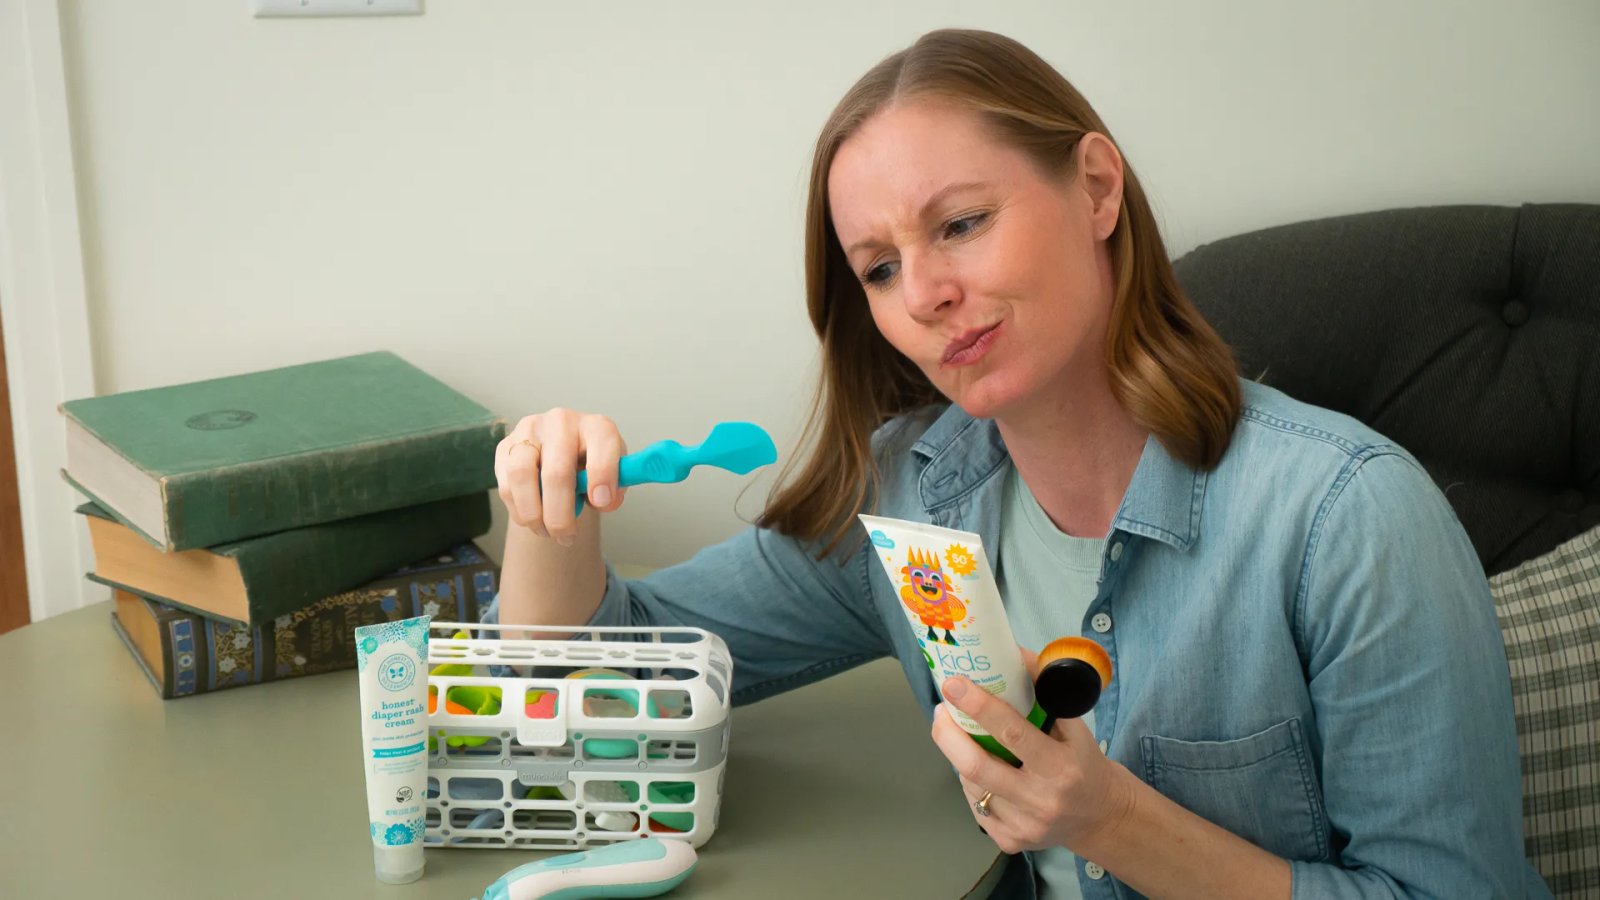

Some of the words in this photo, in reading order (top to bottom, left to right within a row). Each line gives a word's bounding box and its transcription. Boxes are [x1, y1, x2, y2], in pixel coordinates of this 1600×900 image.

[935, 645, 991, 671] kids
[981, 673, 1003, 683] lotion
[382, 698, 415, 711] honest
[371, 710, 404, 721] diaper
[405, 704, 424, 716] rash
[385, 717, 415, 728] cream
[399, 789, 410, 797] NSF
